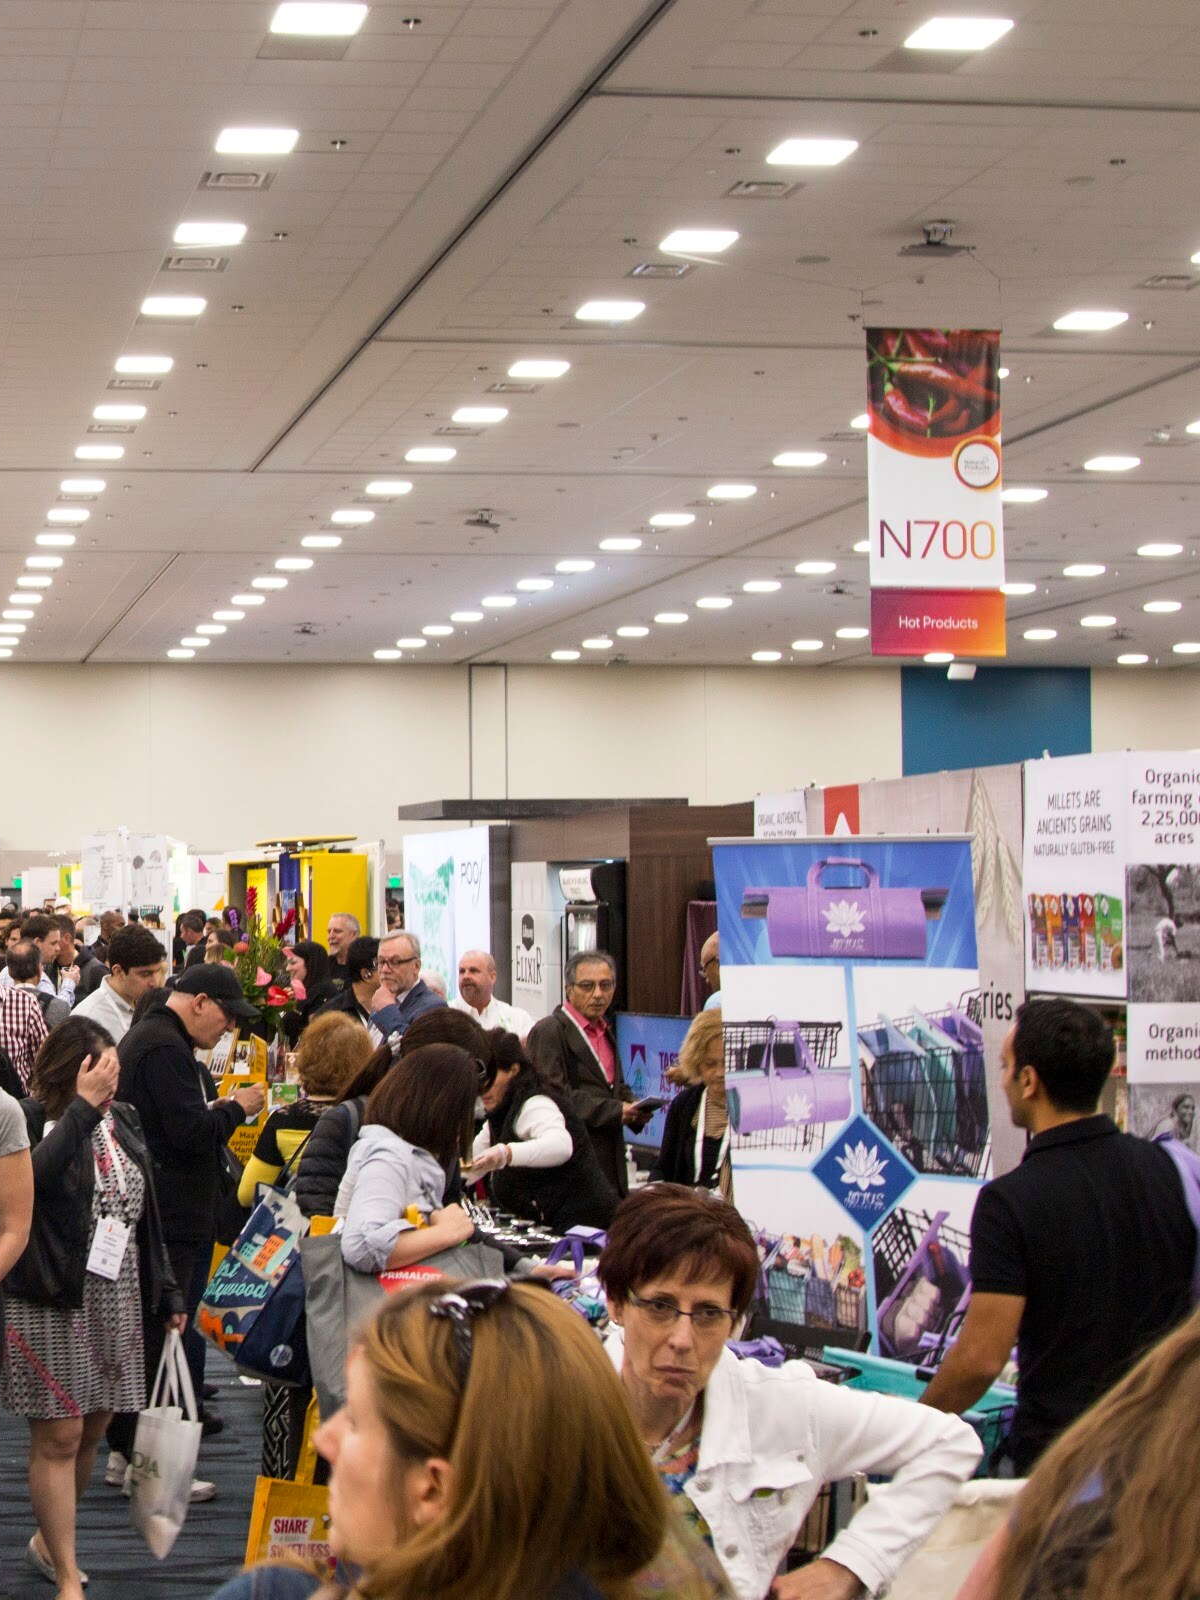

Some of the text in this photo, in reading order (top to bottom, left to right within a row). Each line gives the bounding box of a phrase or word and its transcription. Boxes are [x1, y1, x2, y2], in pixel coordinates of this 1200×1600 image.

[879, 519, 996, 560] N700
[898, 616, 979, 630] Hot Products
[1047, 789, 1102, 810] MILLETS ARE
[1132, 789, 1194, 809] farming
[1037, 814, 1112, 835] ANCIENTS GRAINS
[1141, 810, 1200, 828] 2,25,00
[1154, 832, 1194, 845] acres
[1033, 840, 1115, 857] NATURALLY GLUTEN-FREE
[1148, 1023, 1200, 1043] Organi
[273, 1519, 310, 1534] SHARE
